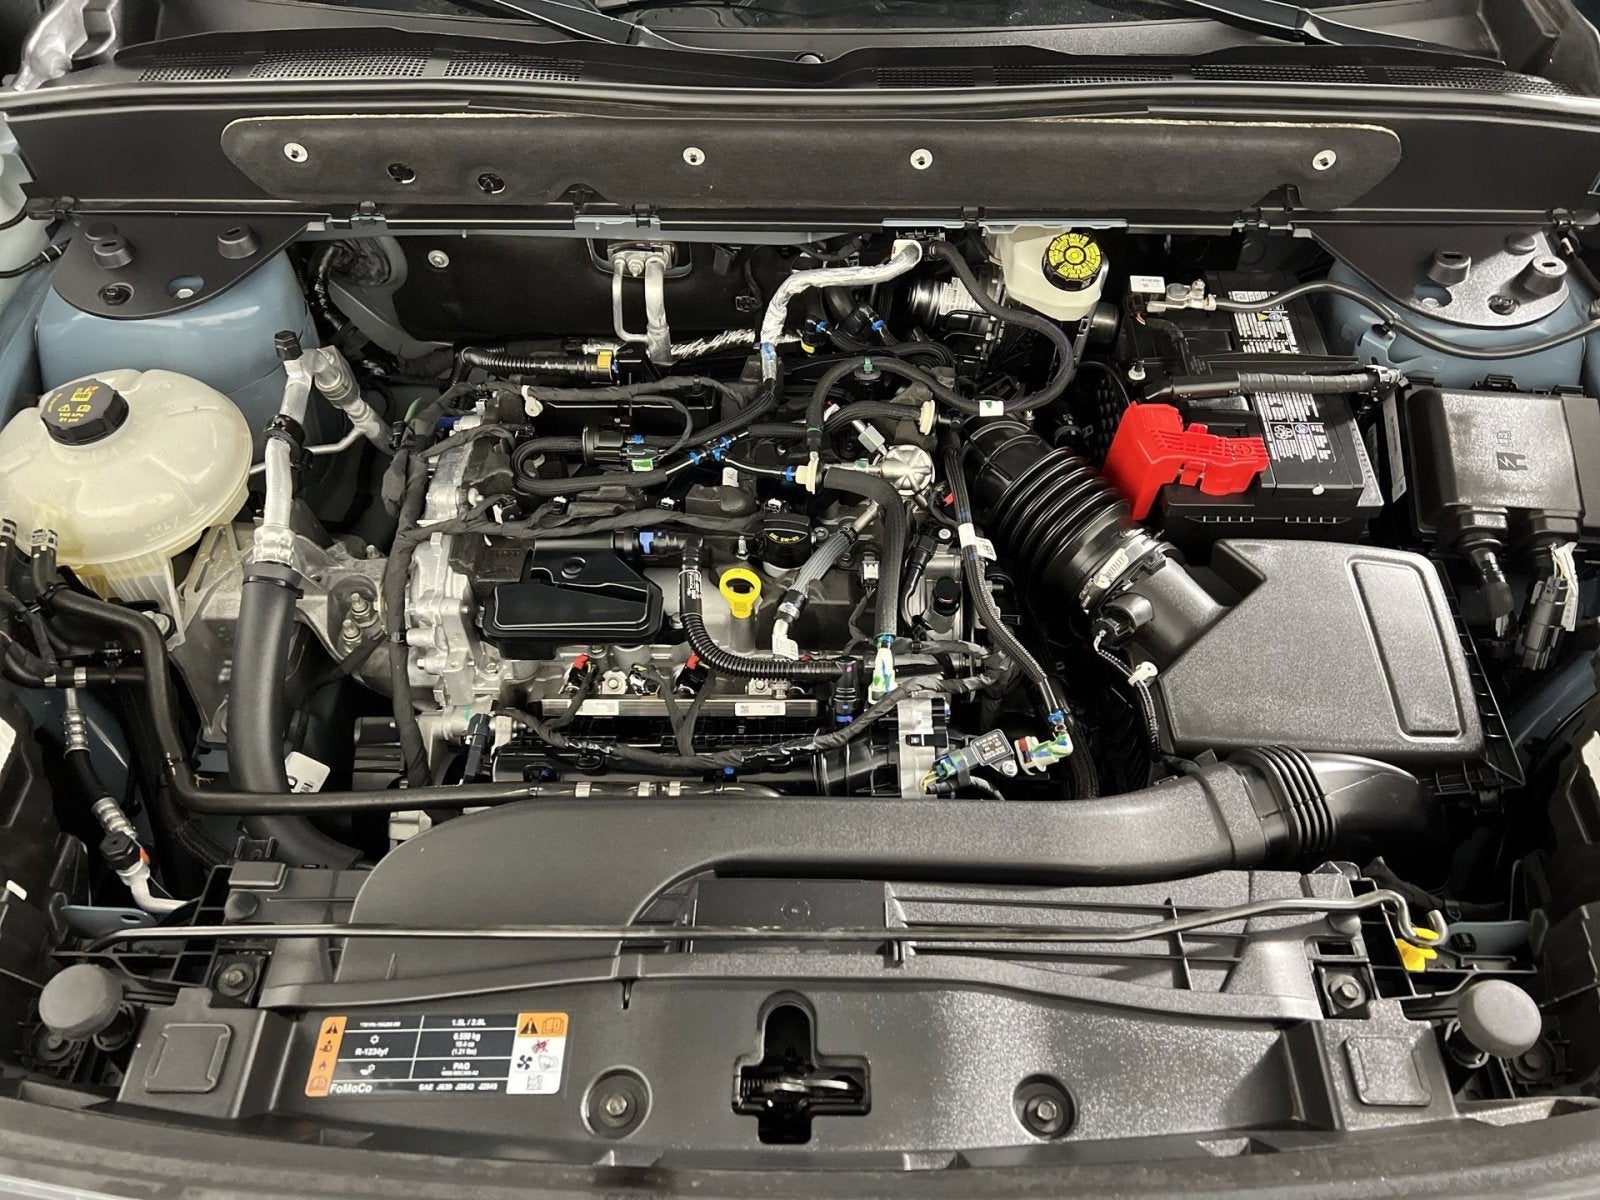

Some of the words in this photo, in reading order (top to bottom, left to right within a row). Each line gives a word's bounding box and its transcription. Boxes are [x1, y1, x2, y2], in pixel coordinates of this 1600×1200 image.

[472, 1032, 481, 1042] kg
[355, 1047, 389, 1057] R-1234yf
[330, 1083, 373, 1093] FoMoCo
[418, 1083, 434, 1091] SAE
